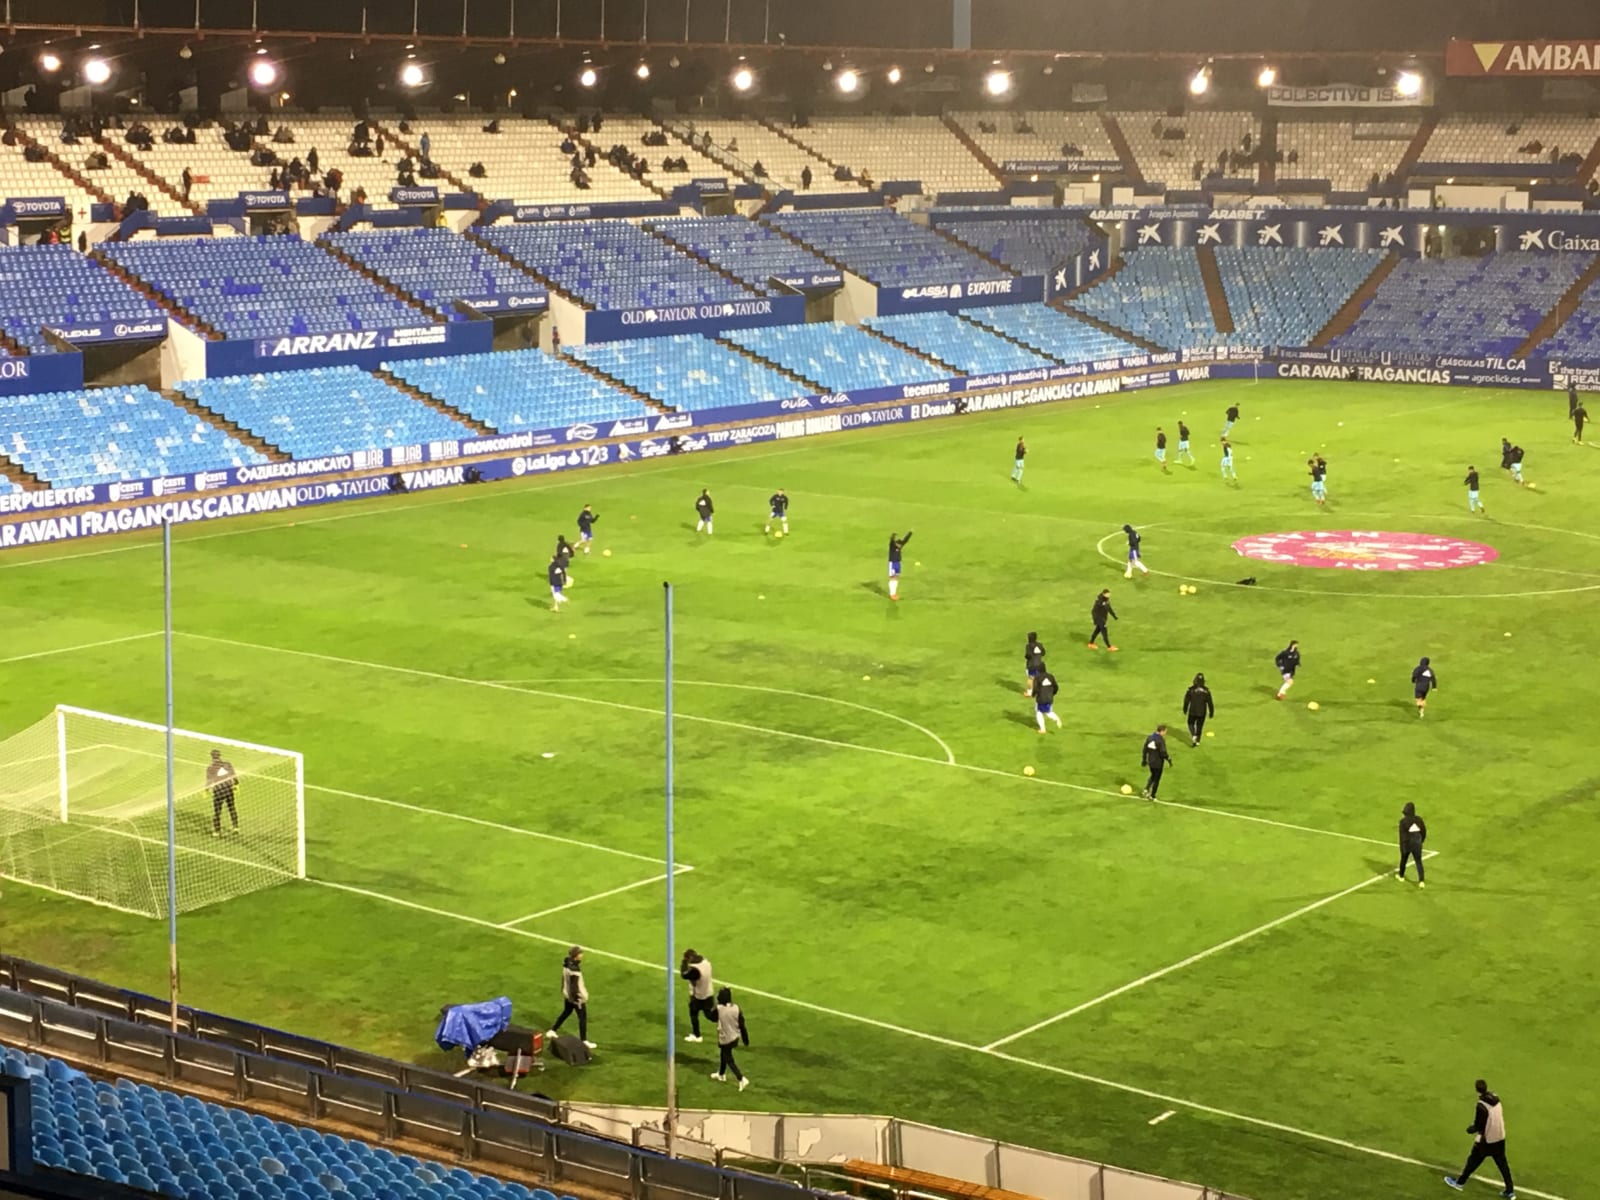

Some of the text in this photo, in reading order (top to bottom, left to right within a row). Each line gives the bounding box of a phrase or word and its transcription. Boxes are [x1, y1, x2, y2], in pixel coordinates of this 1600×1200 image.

[1270, 88, 1370, 101] COLECTIVO
[257, 195, 286, 204] TOYOTA
[407, 190, 435, 199] TOYOTA
[26, 202, 61, 211] TOYOTA
[1548, 230, 1600, 250] Caixa
[967, 279, 1013, 296] EXPOTYRE
[519, 297, 546, 305] LEXUS
[700, 301, 772, 319] OLD TAYLOR
[621, 307, 698, 325] OLD TAYLOR
[64, 328, 101, 338] LEXUS
[127, 324, 163, 333] LEXUS
[272, 331, 378, 357] ARRANZ
[1229, 346, 1264, 354] REALE
[1182, 366, 1210, 381] AMBAR
[1486, 358, 1527, 371] TILCA
[1278, 364, 1450, 384] CARAVAN FRAGANCIAS
[1012, 384, 1073, 406] FRAGANCIAS
[1073, 378, 1120, 398] CARAVAN
[842, 414, 860, 427] OLD
[871, 407, 904, 423] TAYLOR
[910, 405, 920, 420] El
[708, 431, 730, 443] TRYP
[730, 425, 776, 439] ZARAGOZA
[463, 432, 533, 455] movicontrol
[527, 445, 609, 470] LaLiga 123
[250, 455, 351, 482] AZULEJOS MONCAYO
[414, 466, 465, 489] AMBAR
[297, 476, 390, 501] OLD TAYLOR
[0, 487, 297, 547] RAVAN FRAGANCIAS CARAVAN
